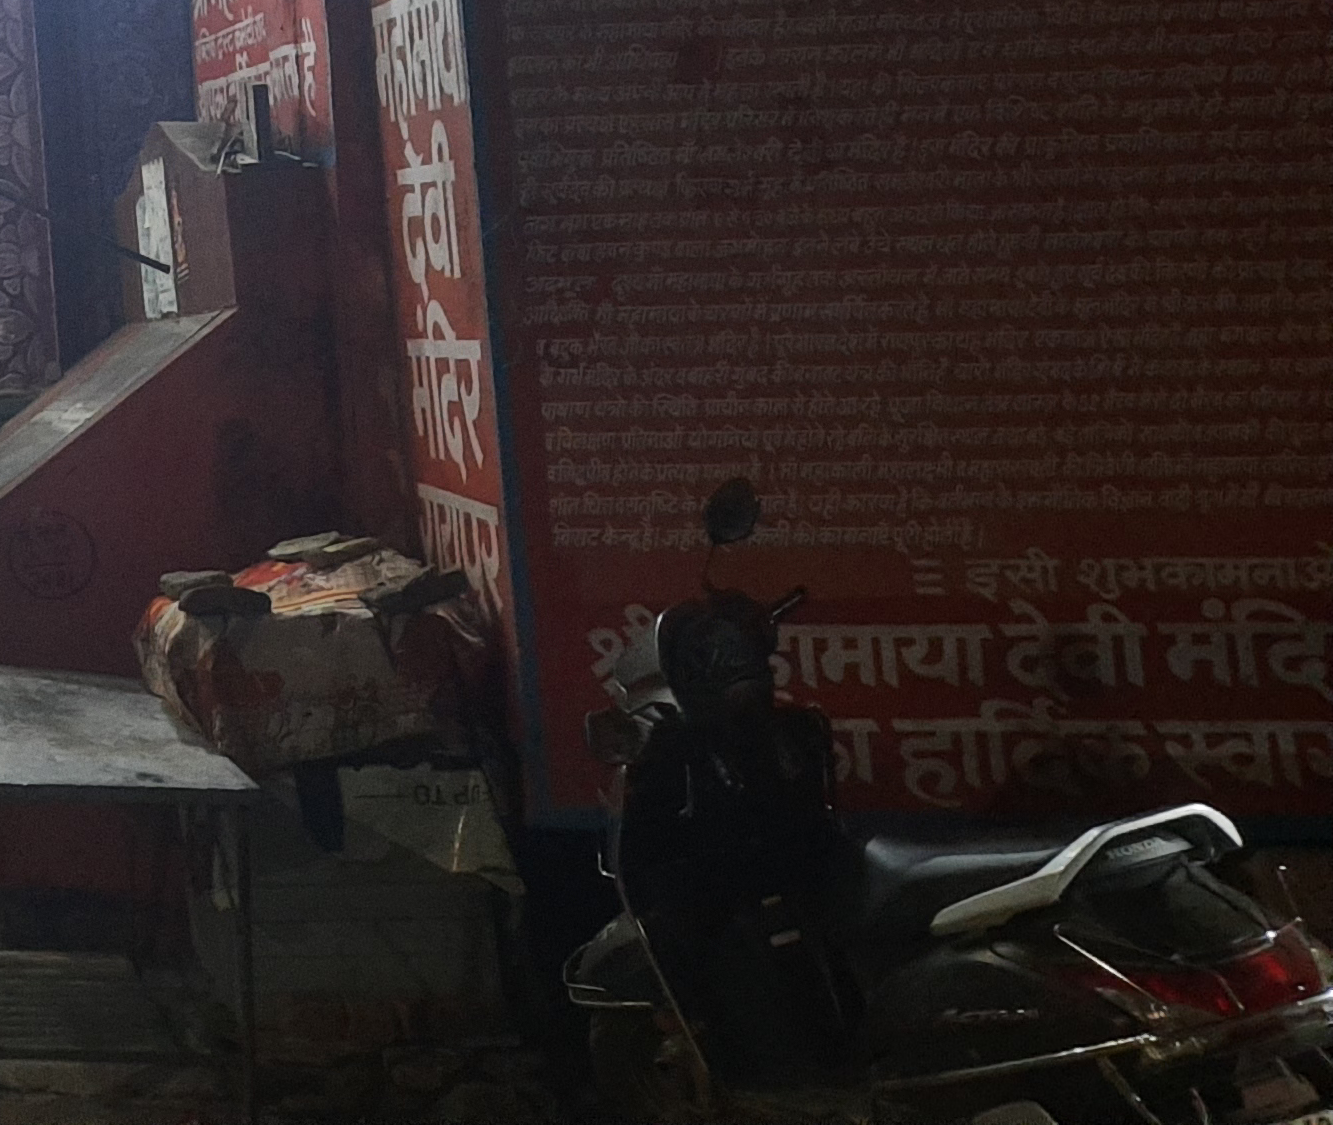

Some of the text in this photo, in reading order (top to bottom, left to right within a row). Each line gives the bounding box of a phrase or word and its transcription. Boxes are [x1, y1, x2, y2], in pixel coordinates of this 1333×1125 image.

[394, 121, 464, 306] देवी
[405, 302, 485, 485] मंदिर
[964, 547, 1062, 601] इसी
[769, 622, 994, 703] हामाया
[999, 598, 1148, 703] देवी
[892, 698, 1151, 810] हार्दिक
